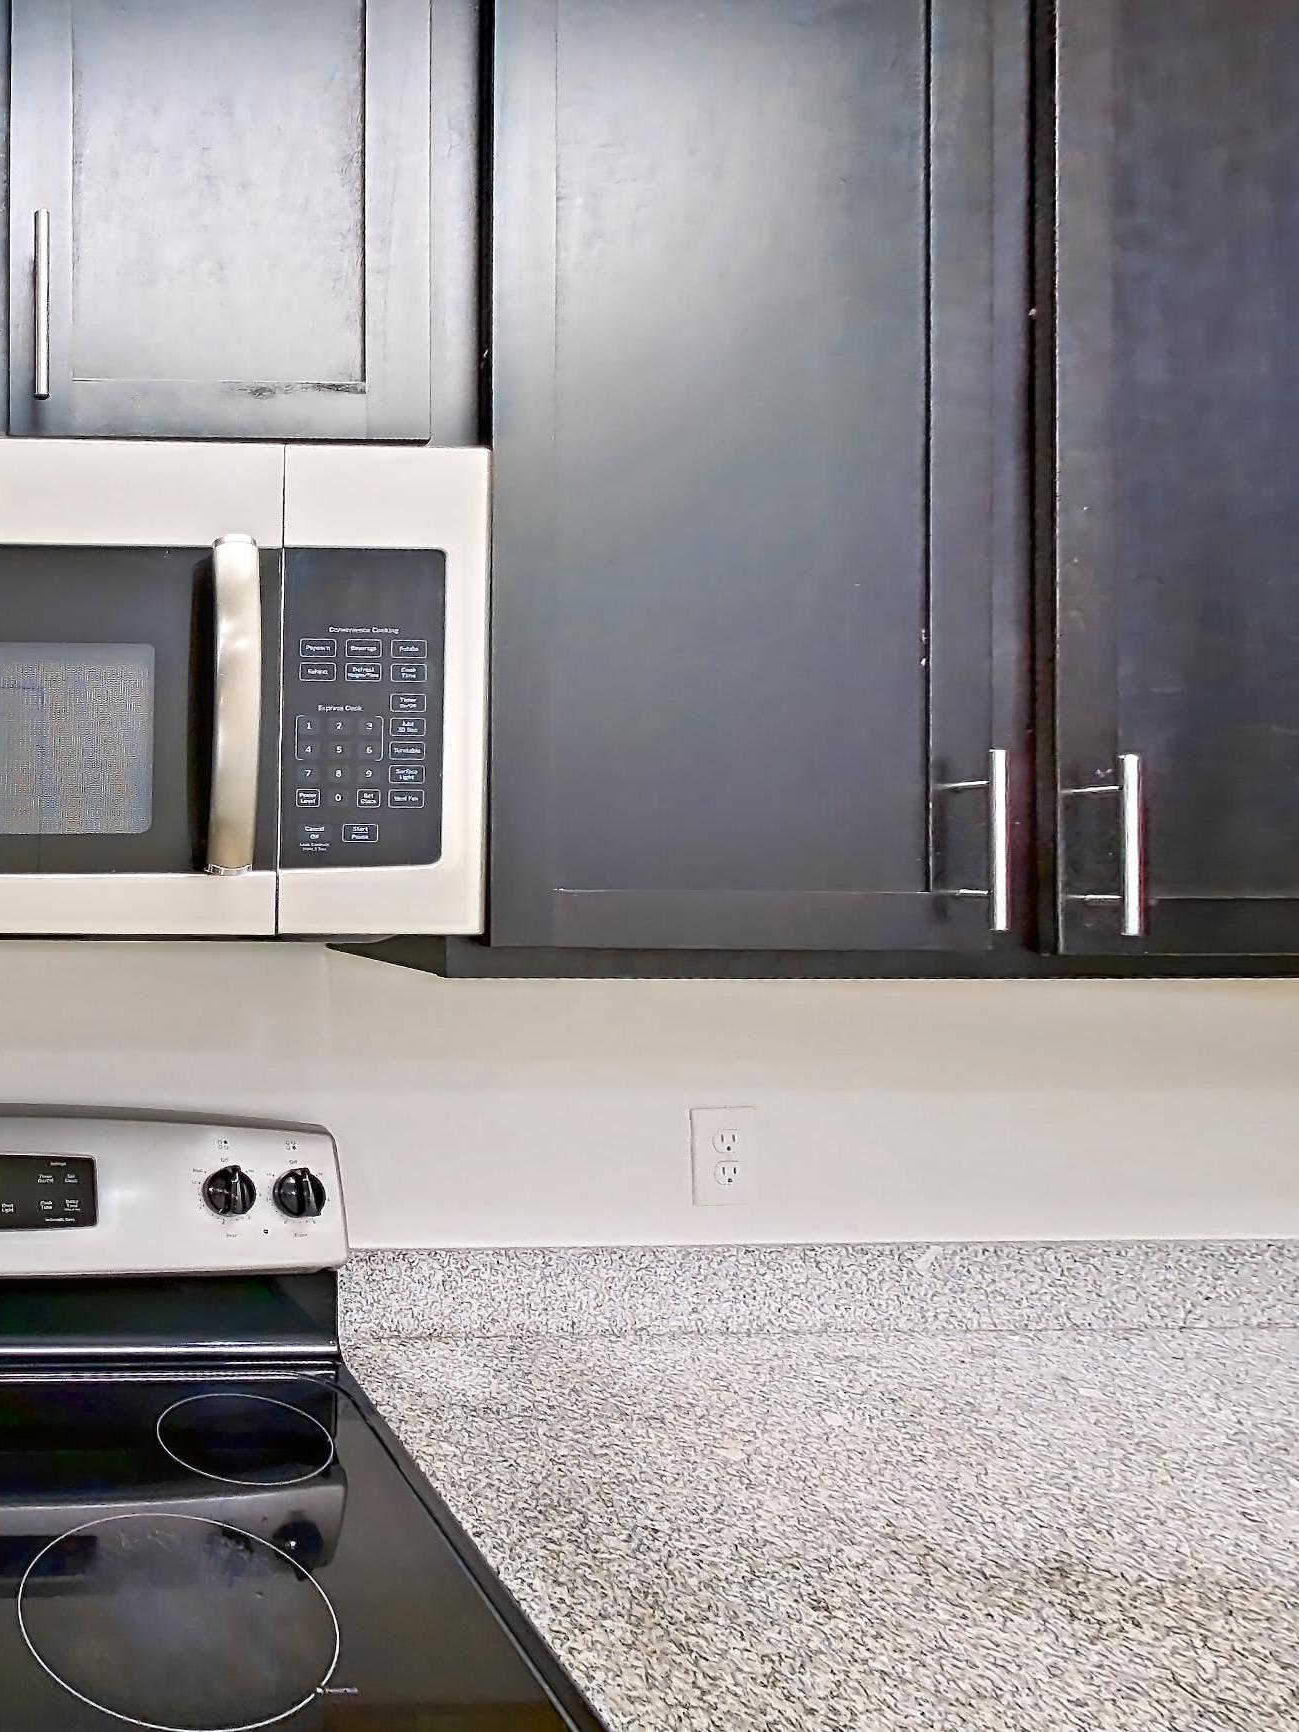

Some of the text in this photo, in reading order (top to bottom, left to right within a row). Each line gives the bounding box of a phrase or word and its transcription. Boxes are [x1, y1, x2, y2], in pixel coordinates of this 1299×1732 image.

[328, 626, 400, 635] Convenience Cooking
[318, 704, 343, 713] Express
[336, 722, 343, 730] 2
[366, 722, 373, 730] 3
[366, 746, 373, 754] 6
[305, 769, 372, 778] 7 8 9
[335, 793, 342, 801] 0
